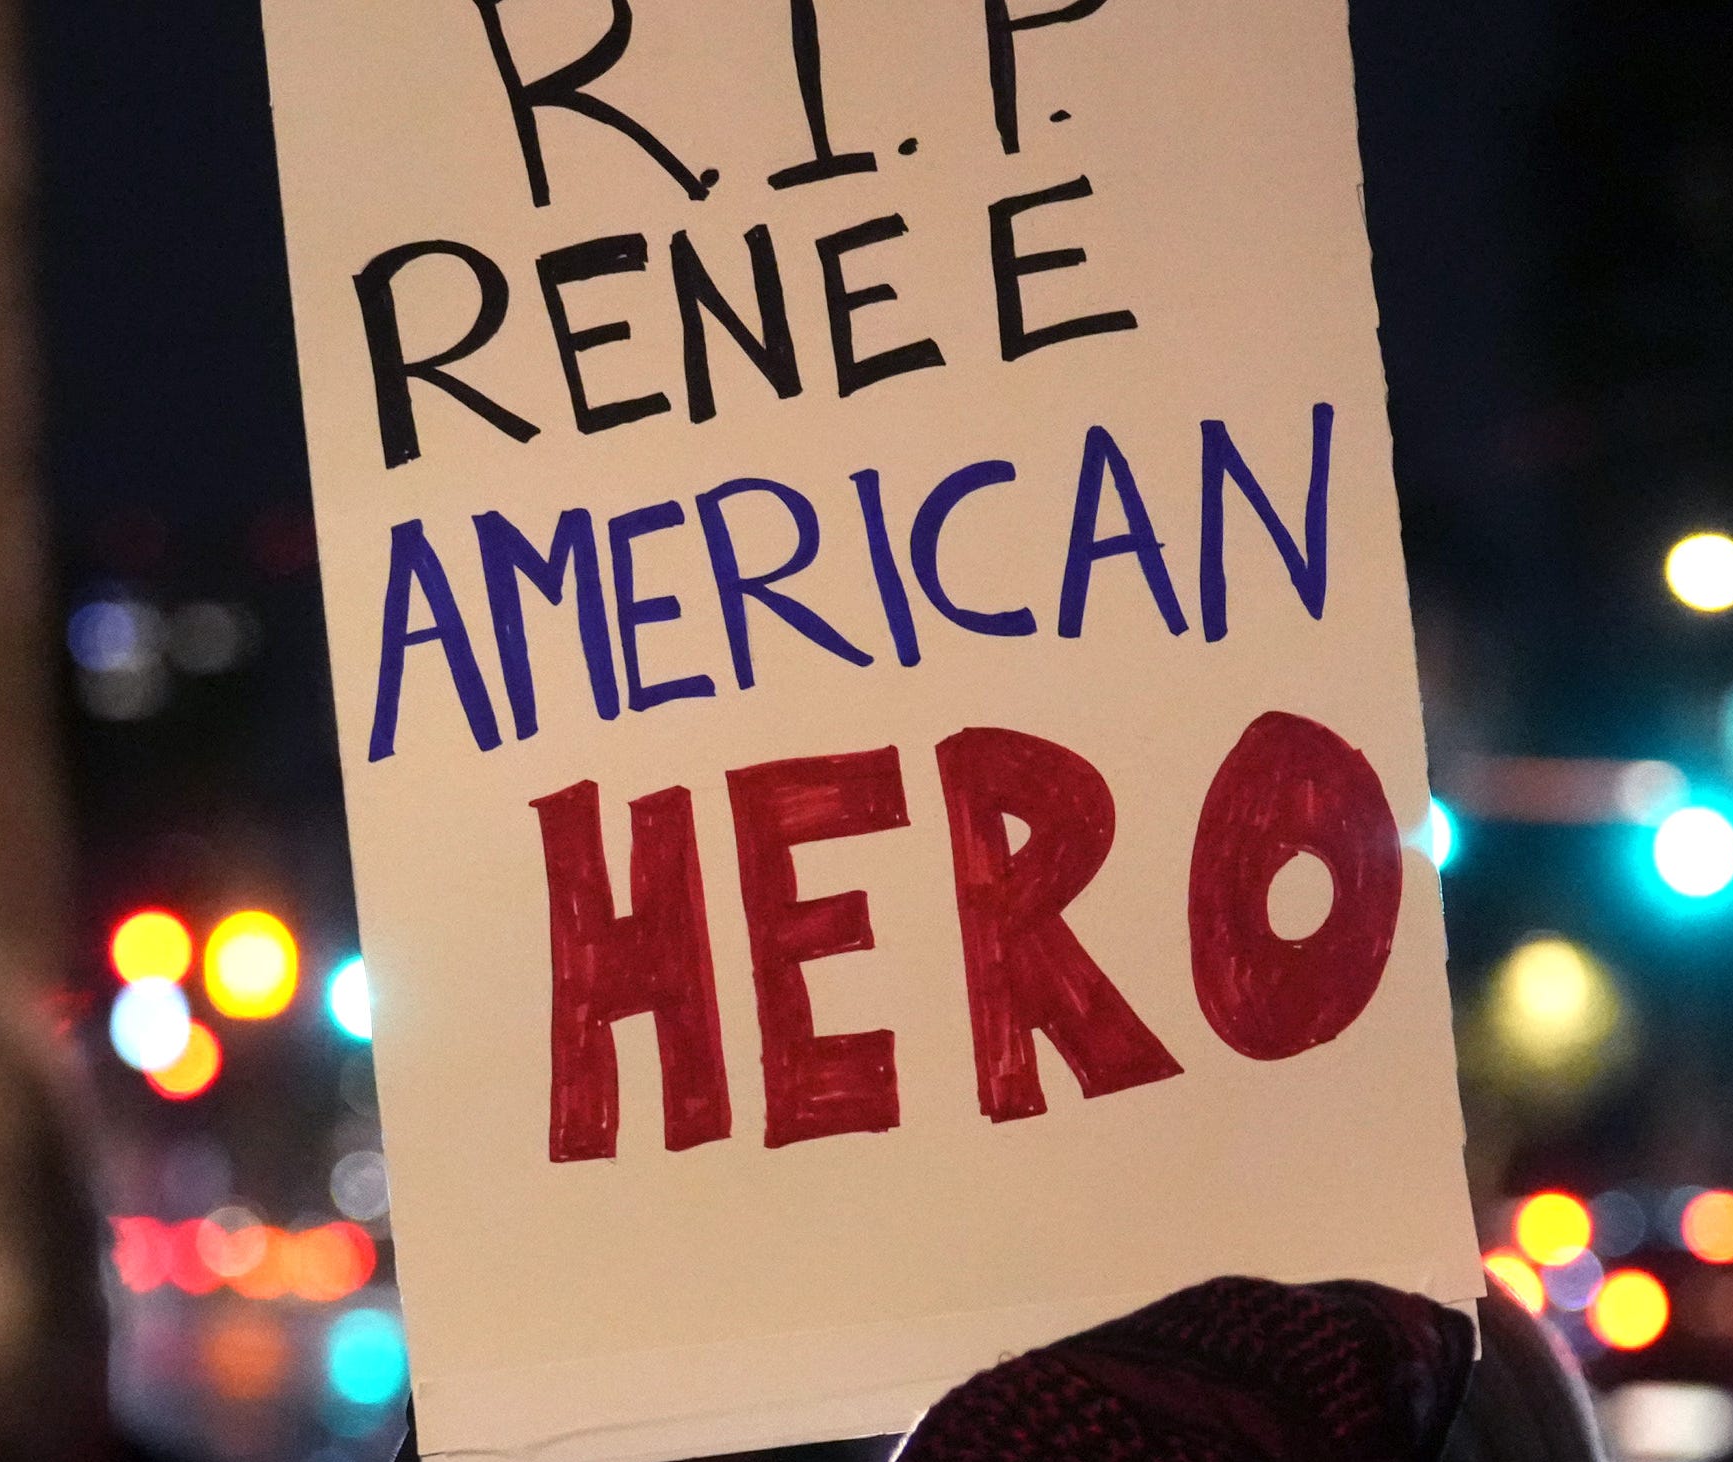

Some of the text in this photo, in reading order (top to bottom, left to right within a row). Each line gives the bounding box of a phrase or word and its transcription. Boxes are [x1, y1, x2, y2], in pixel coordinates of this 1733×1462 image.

[353, 175, 1137, 469] RENEE
[371, 403, 1333, 761] AMERICAN
[530, 712, 1403, 1162] HERO
